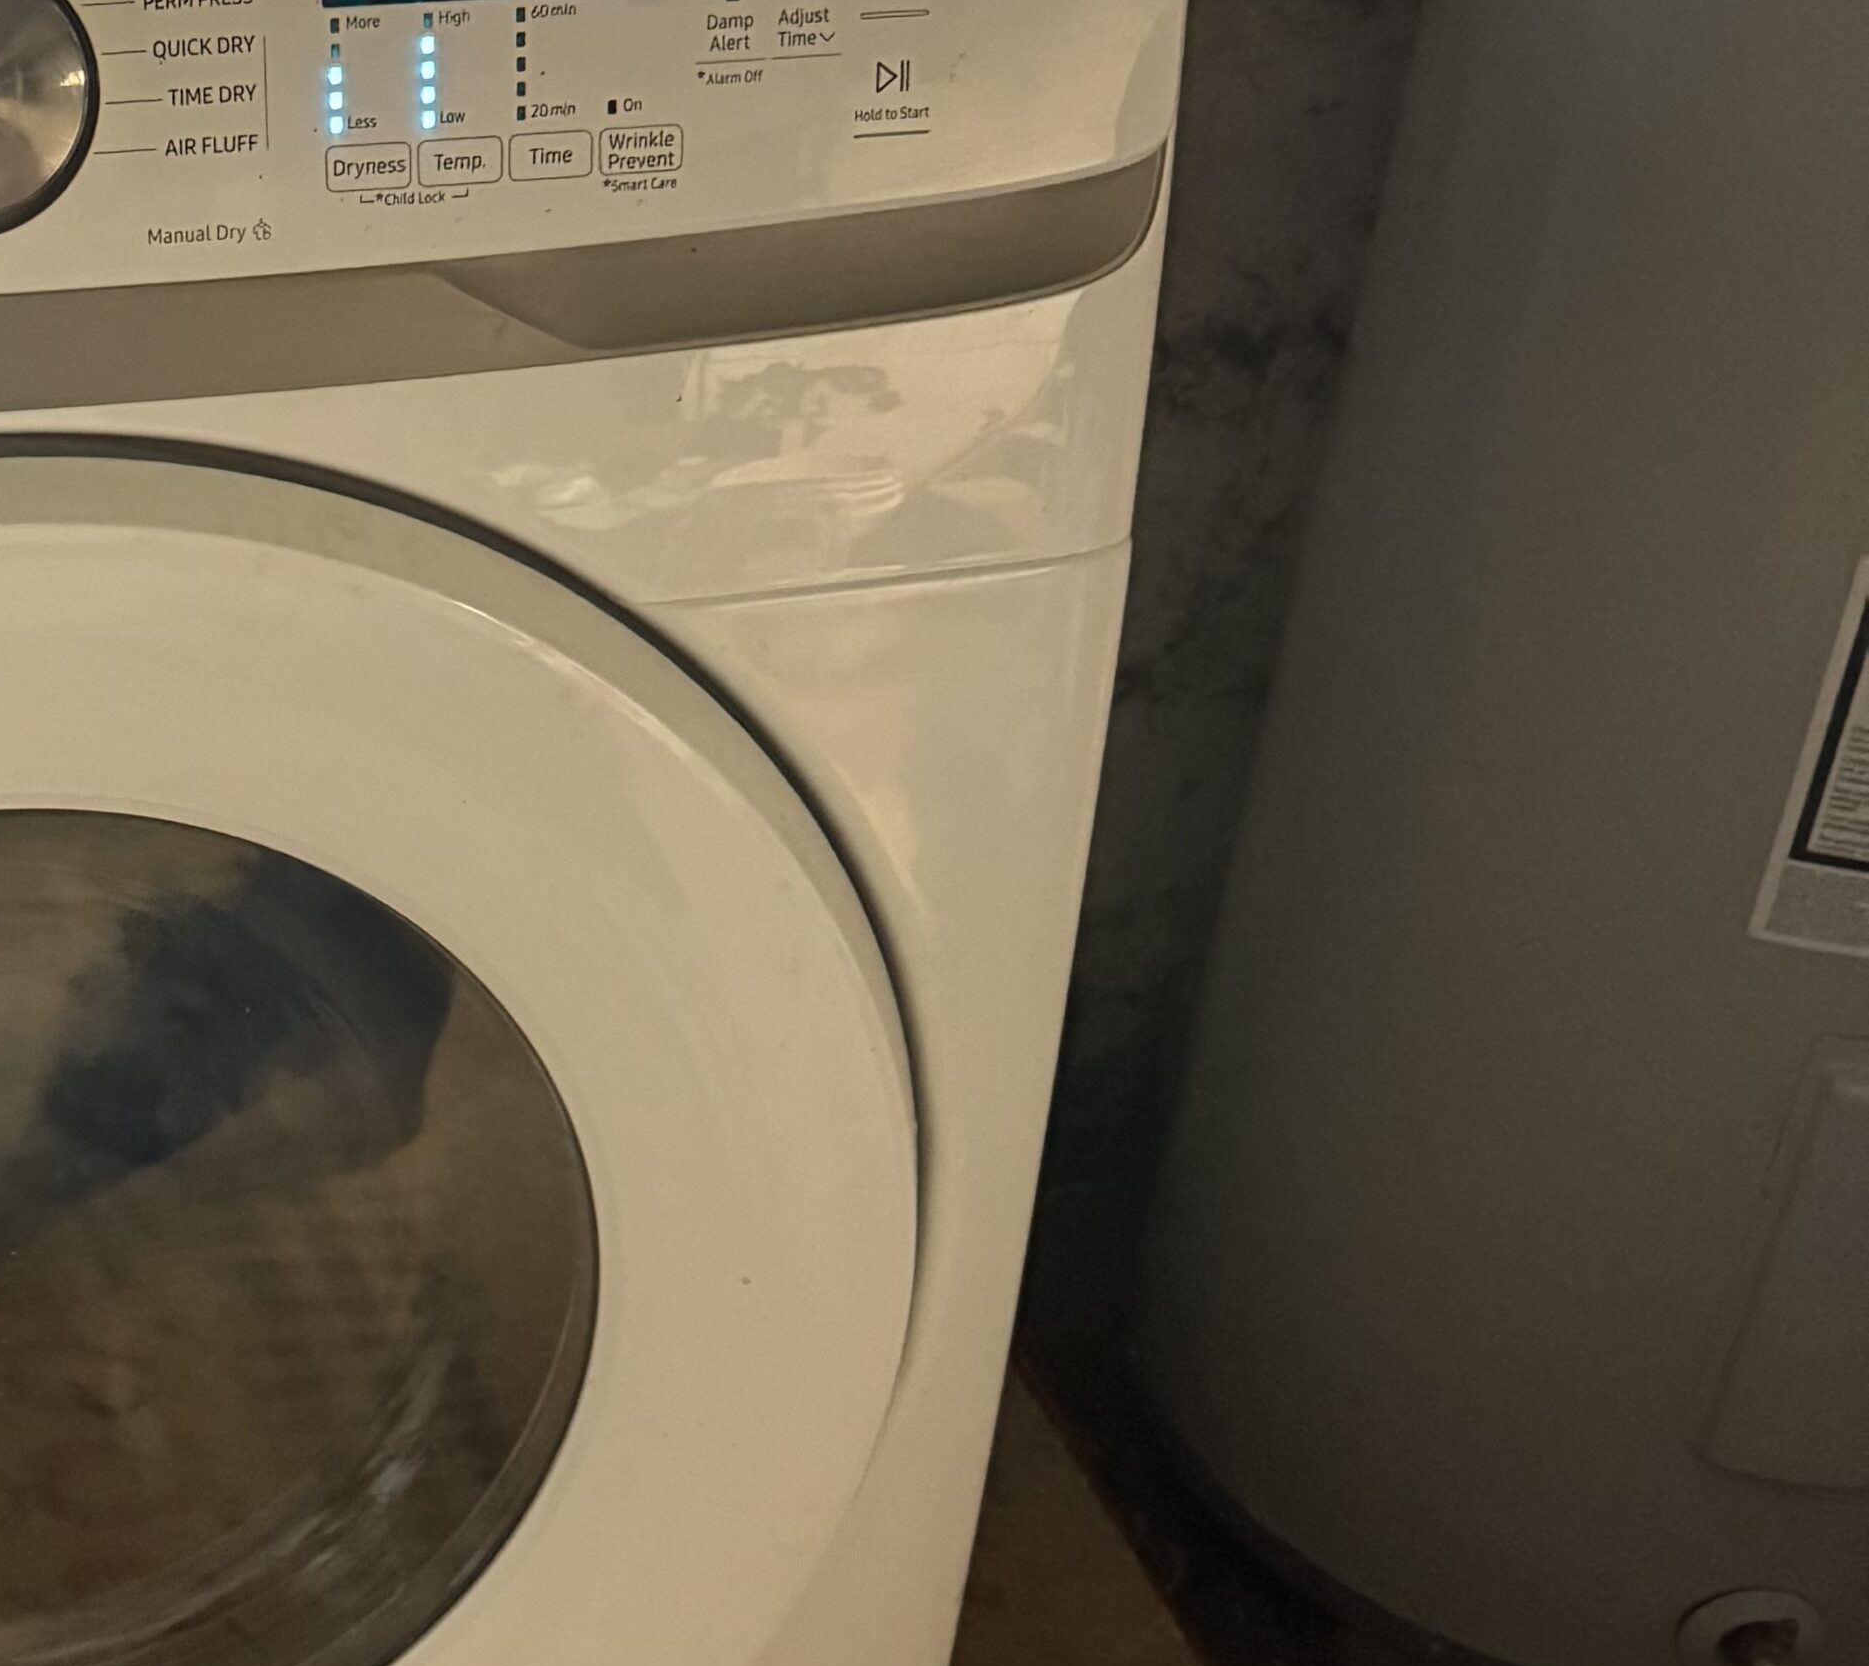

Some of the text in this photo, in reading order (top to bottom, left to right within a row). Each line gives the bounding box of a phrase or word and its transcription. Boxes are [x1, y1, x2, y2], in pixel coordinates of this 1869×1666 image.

[347, 16, 380, 29] More
[439, 10, 470, 26] High
[707, 14, 753, 31] Damp
[778, 8, 829, 27] Adjust
[710, 35, 750, 51] Alert
[778, 31, 816, 47] Time
[153, 35, 255, 60] QUICK DRY
[744, 70, 763, 83] Off
[168, 84, 256, 105] TIME DRY
[624, 98, 642, 112] On
[440, 111, 465, 123] Low
[855, 106, 929, 122] Hold to Start
[348, 116, 376, 129] Less
[166, 134, 258, 156] AIR FLUFF
[607, 128, 674, 150] Wrinkle
[434, 154, 485, 172] Temp.
[529, 148, 572, 164] Time
[609, 152, 676, 171] Prevent
[334, 159, 406, 179] Dryness
[651, 177, 677, 189] Care
[419, 191, 445, 204] Lock
[148, 225, 246, 244] Manual Dry
